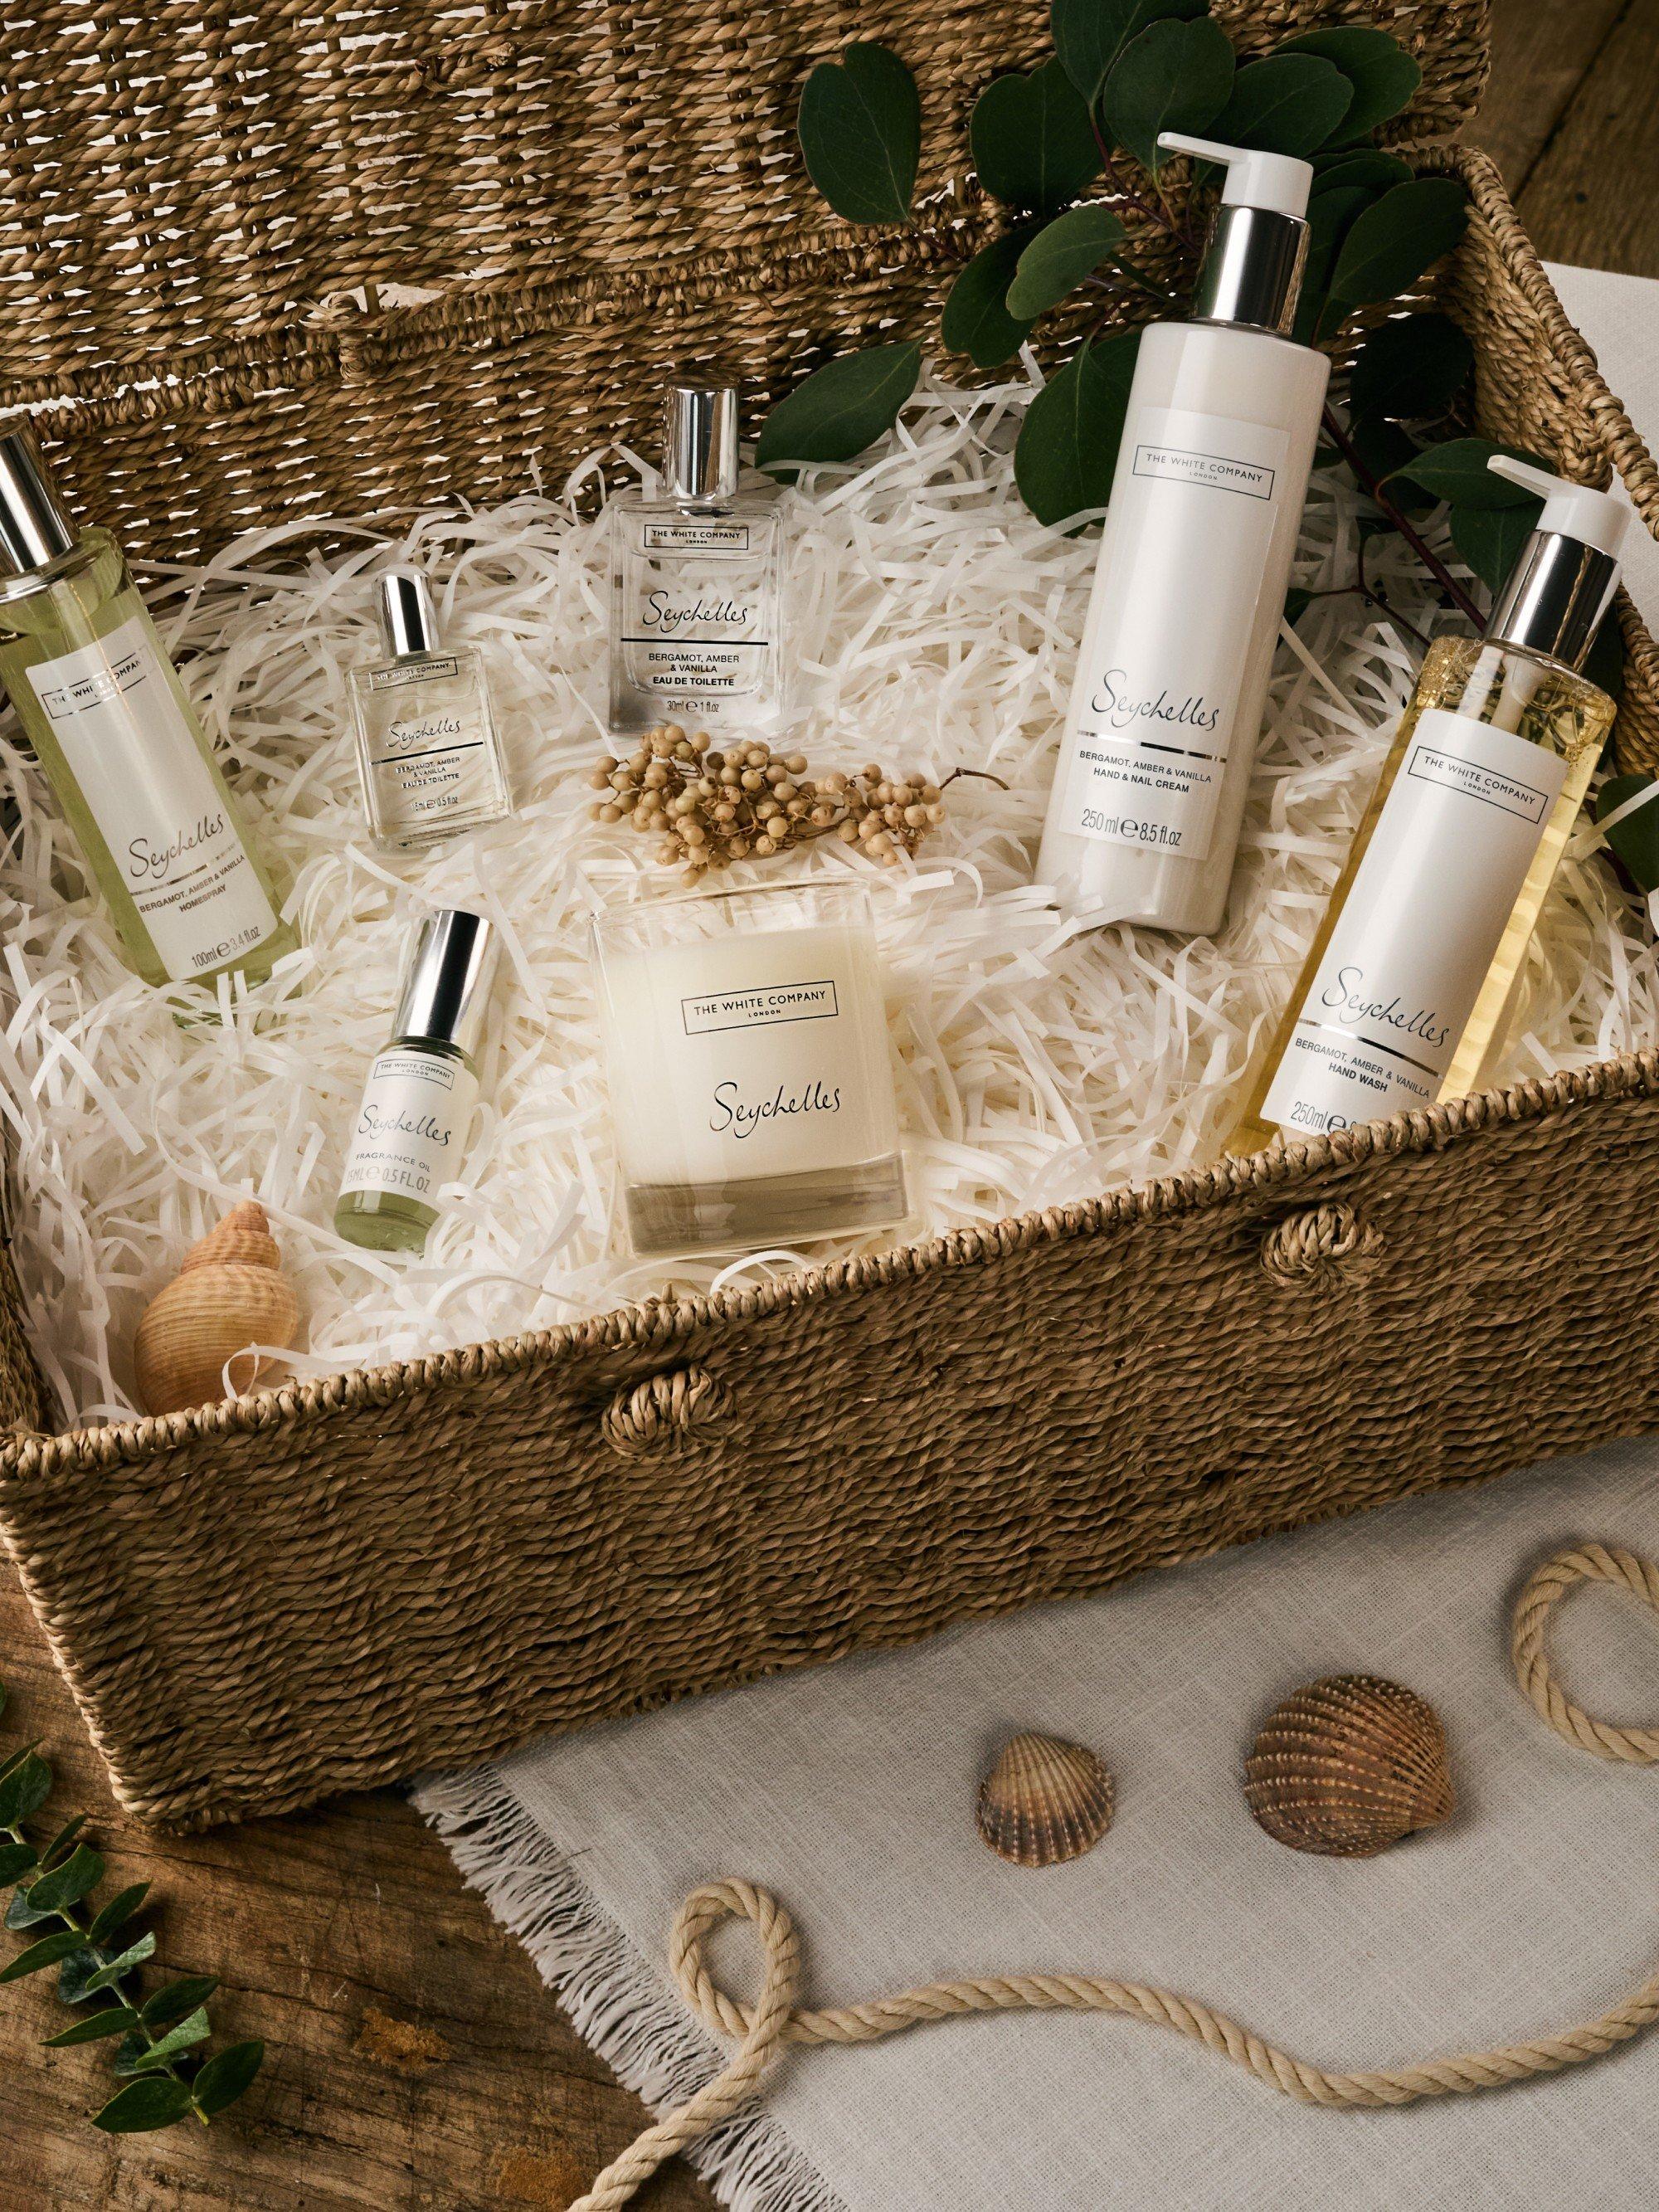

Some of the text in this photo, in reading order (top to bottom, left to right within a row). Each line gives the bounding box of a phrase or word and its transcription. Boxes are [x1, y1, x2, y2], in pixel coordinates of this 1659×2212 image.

[1146, 453, 1262, 483] THE WHITE COMPANY
[1190, 471, 1218, 480] LONDON
[700, 531, 741, 539] COMPANY
[642, 591, 748, 633] Seychelles
[416, 662, 450, 673] COMPANY
[649, 653, 740, 663] BERGAMOT, AMBER
[679, 665, 718, 673] VANILLA
[653, 676, 672, 685] EAU
[689, 678, 734, 686] TOILETTE
[1092, 669, 1220, 731] Seychelles
[386, 718, 461, 750] Seychelles
[419, 767, 446, 777] VANILLA
[437, 757, 460, 766] AMBER
[1133, 762, 1165, 775] AMBER
[1175, 769, 1212, 783] VANILLA
[401, 781, 416, 789] EAU
[428, 772, 460, 784] TOILETTE
[1093, 767, 1190, 793] HAND & NAIL CREAM
[1424, 756, 1535, 806] THE WHITE COMPANY
[1463, 782, 1491, 795] LONDON
[129, 814, 223, 879] Seychelles
[1140, 822, 1158, 842] 8.5
[1159, 826, 1182, 846] fl.oz
[188, 876, 213, 895] AMBER
[219, 855, 246, 876] VANILLA
[179, 884, 227, 913] HOMESPRAY
[230, 933, 246, 951] 3.4
[694, 990, 826, 1016] THE WHITE COMPANY
[748, 1009, 781, 1018] LONDON
[1321, 967, 1450, 1047] Seychelles
[420, 1065, 450, 1079] COMPANY
[1296, 1038, 1430, 1099] BERGAMOT, AMBER & VANILLA
[1329, 1062, 1389, 1093] HAND WASH
[709, 1080, 840, 1139] Seychelles
[358, 1104, 451, 1147] Seychelles
[356, 1152, 431, 1173] FRAGRANCE OIL
[382, 1167, 398, 1183] 0.5
[399, 1171, 431, 1194] FL.OZ
